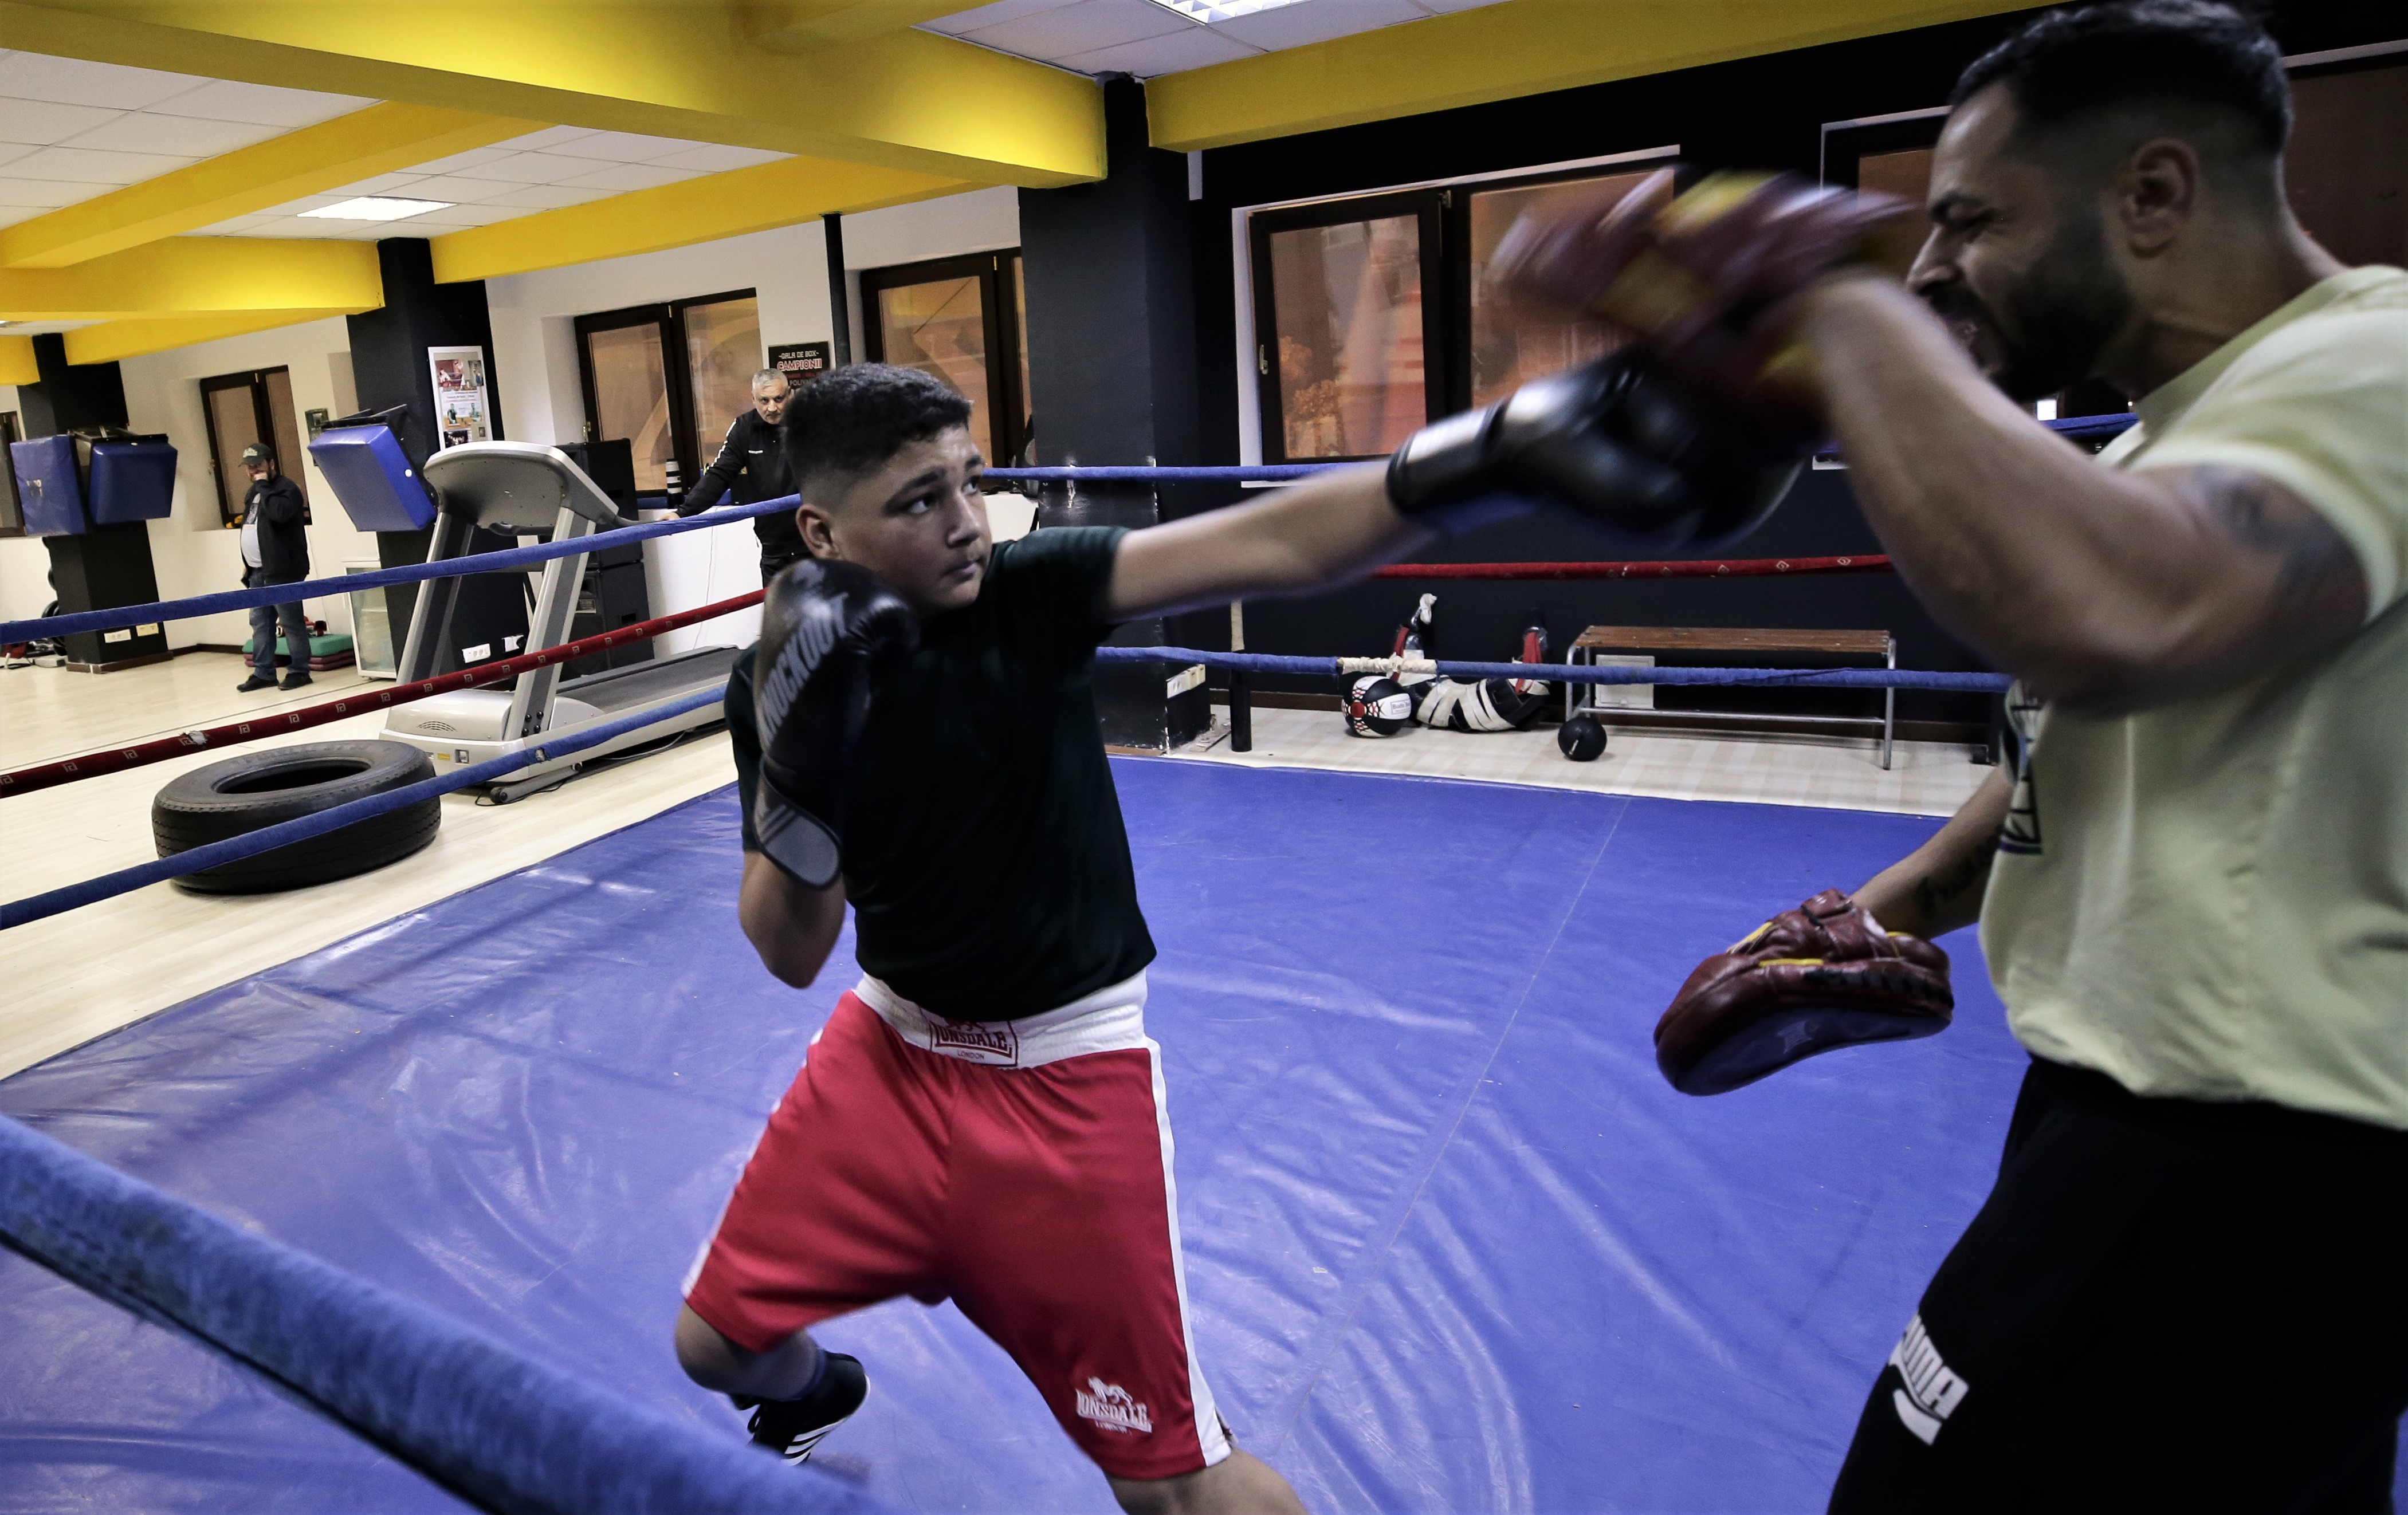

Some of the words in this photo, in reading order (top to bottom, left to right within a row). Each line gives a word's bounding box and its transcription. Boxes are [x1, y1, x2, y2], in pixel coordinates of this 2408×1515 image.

[777, 358, 823, 372] CAMPIONII
[930, 1020, 1013, 1058] LONSDALE
[957, 1050, 985, 1060] LONDON
[1075, 1388, 1153, 1433] LONSDALE
